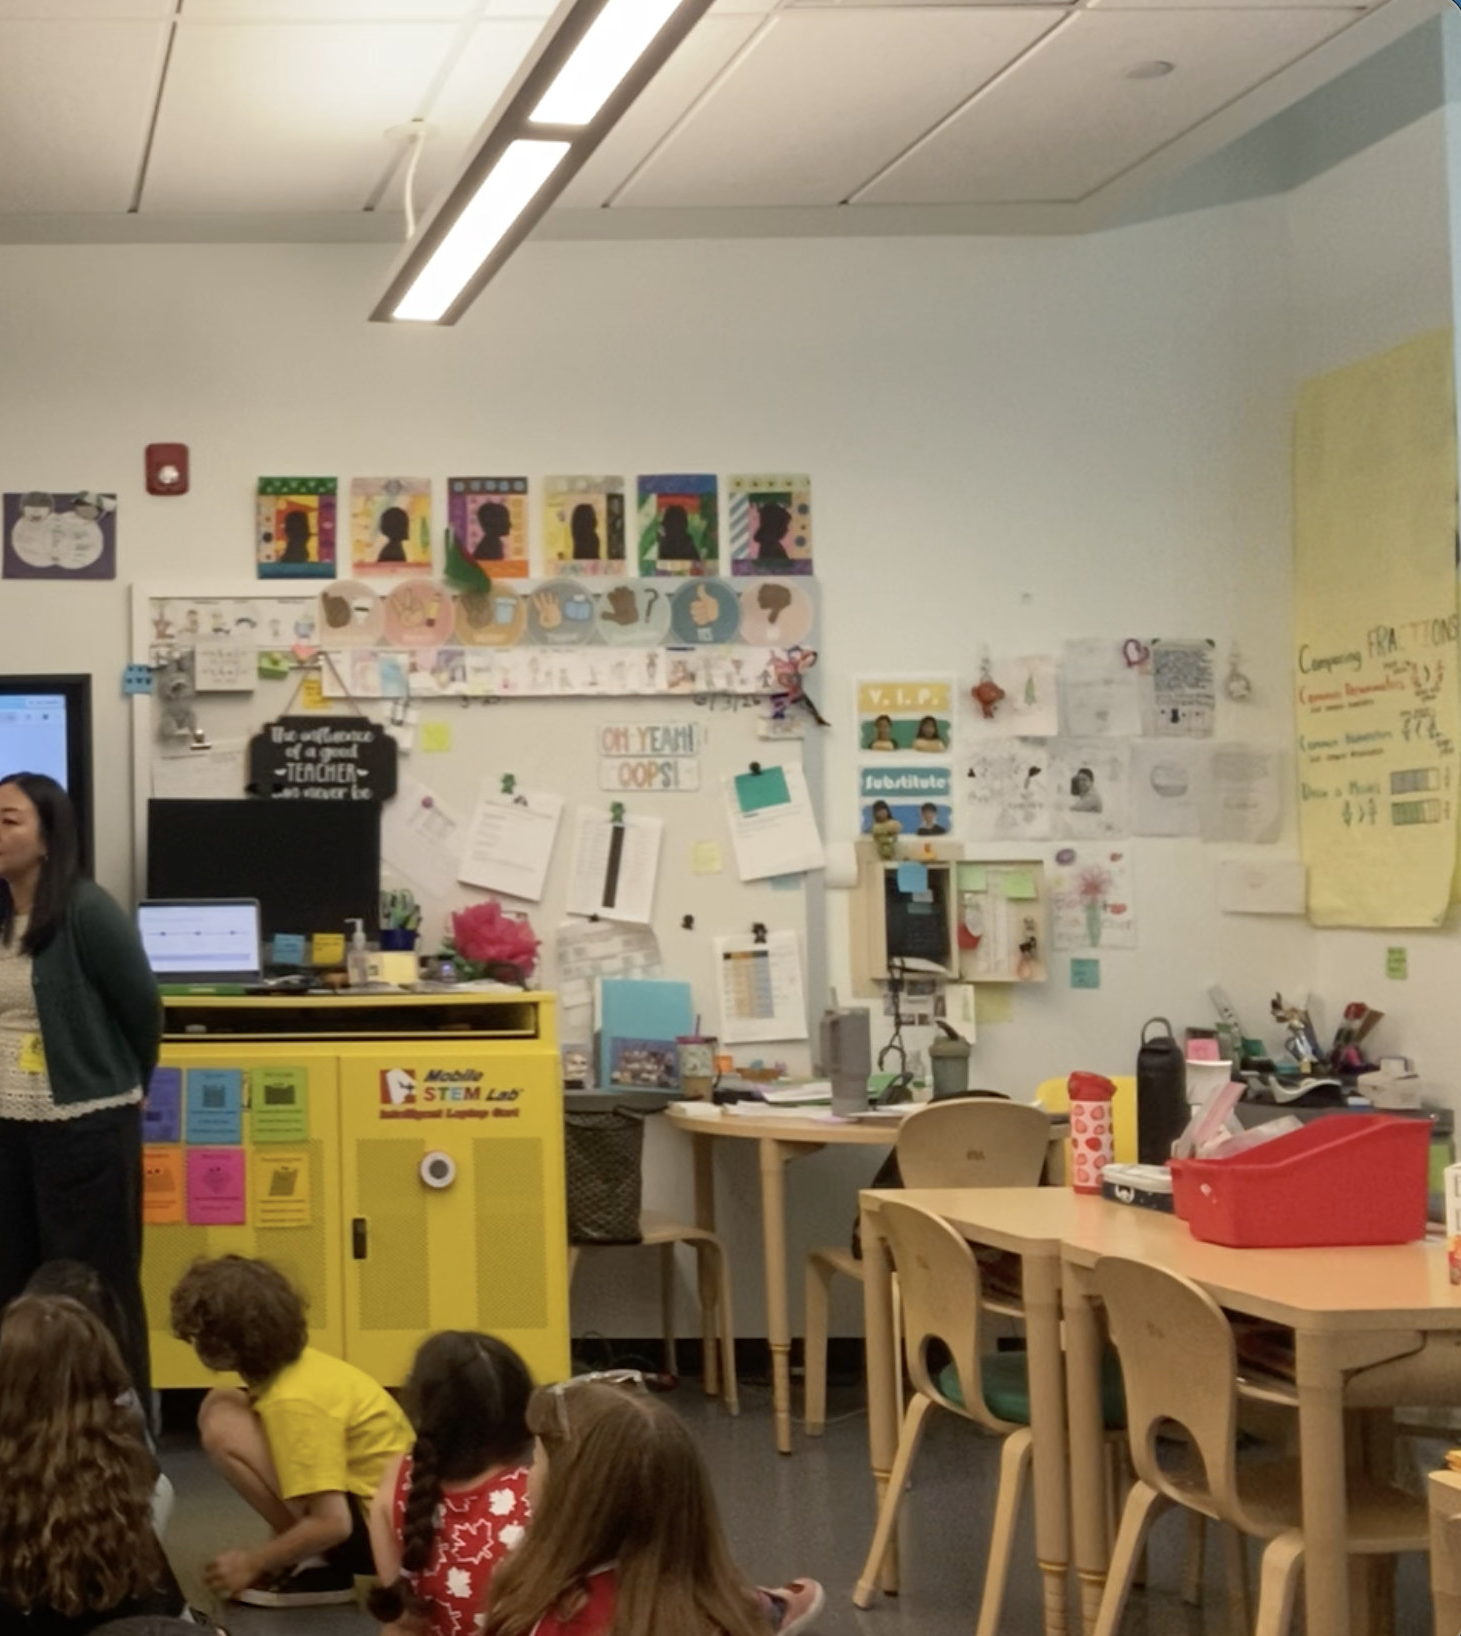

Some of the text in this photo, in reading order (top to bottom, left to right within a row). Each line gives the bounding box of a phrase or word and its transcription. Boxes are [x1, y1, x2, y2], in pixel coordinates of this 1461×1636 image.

[271, 726, 375, 745] The influence
[602, 724, 694, 752] OH YEAH!
[285, 743, 359, 763] of a good
[287, 762, 357, 783] TEACHER
[618, 759, 680, 788] OOPS!
[865, 773, 947, 790] Substitute
[423, 1068, 484, 1083] Mobile
[423, 1086, 482, 1102] STEM
[379, 1108, 443, 1121] Intelligent
[446, 1108, 489, 1121] Laptop
